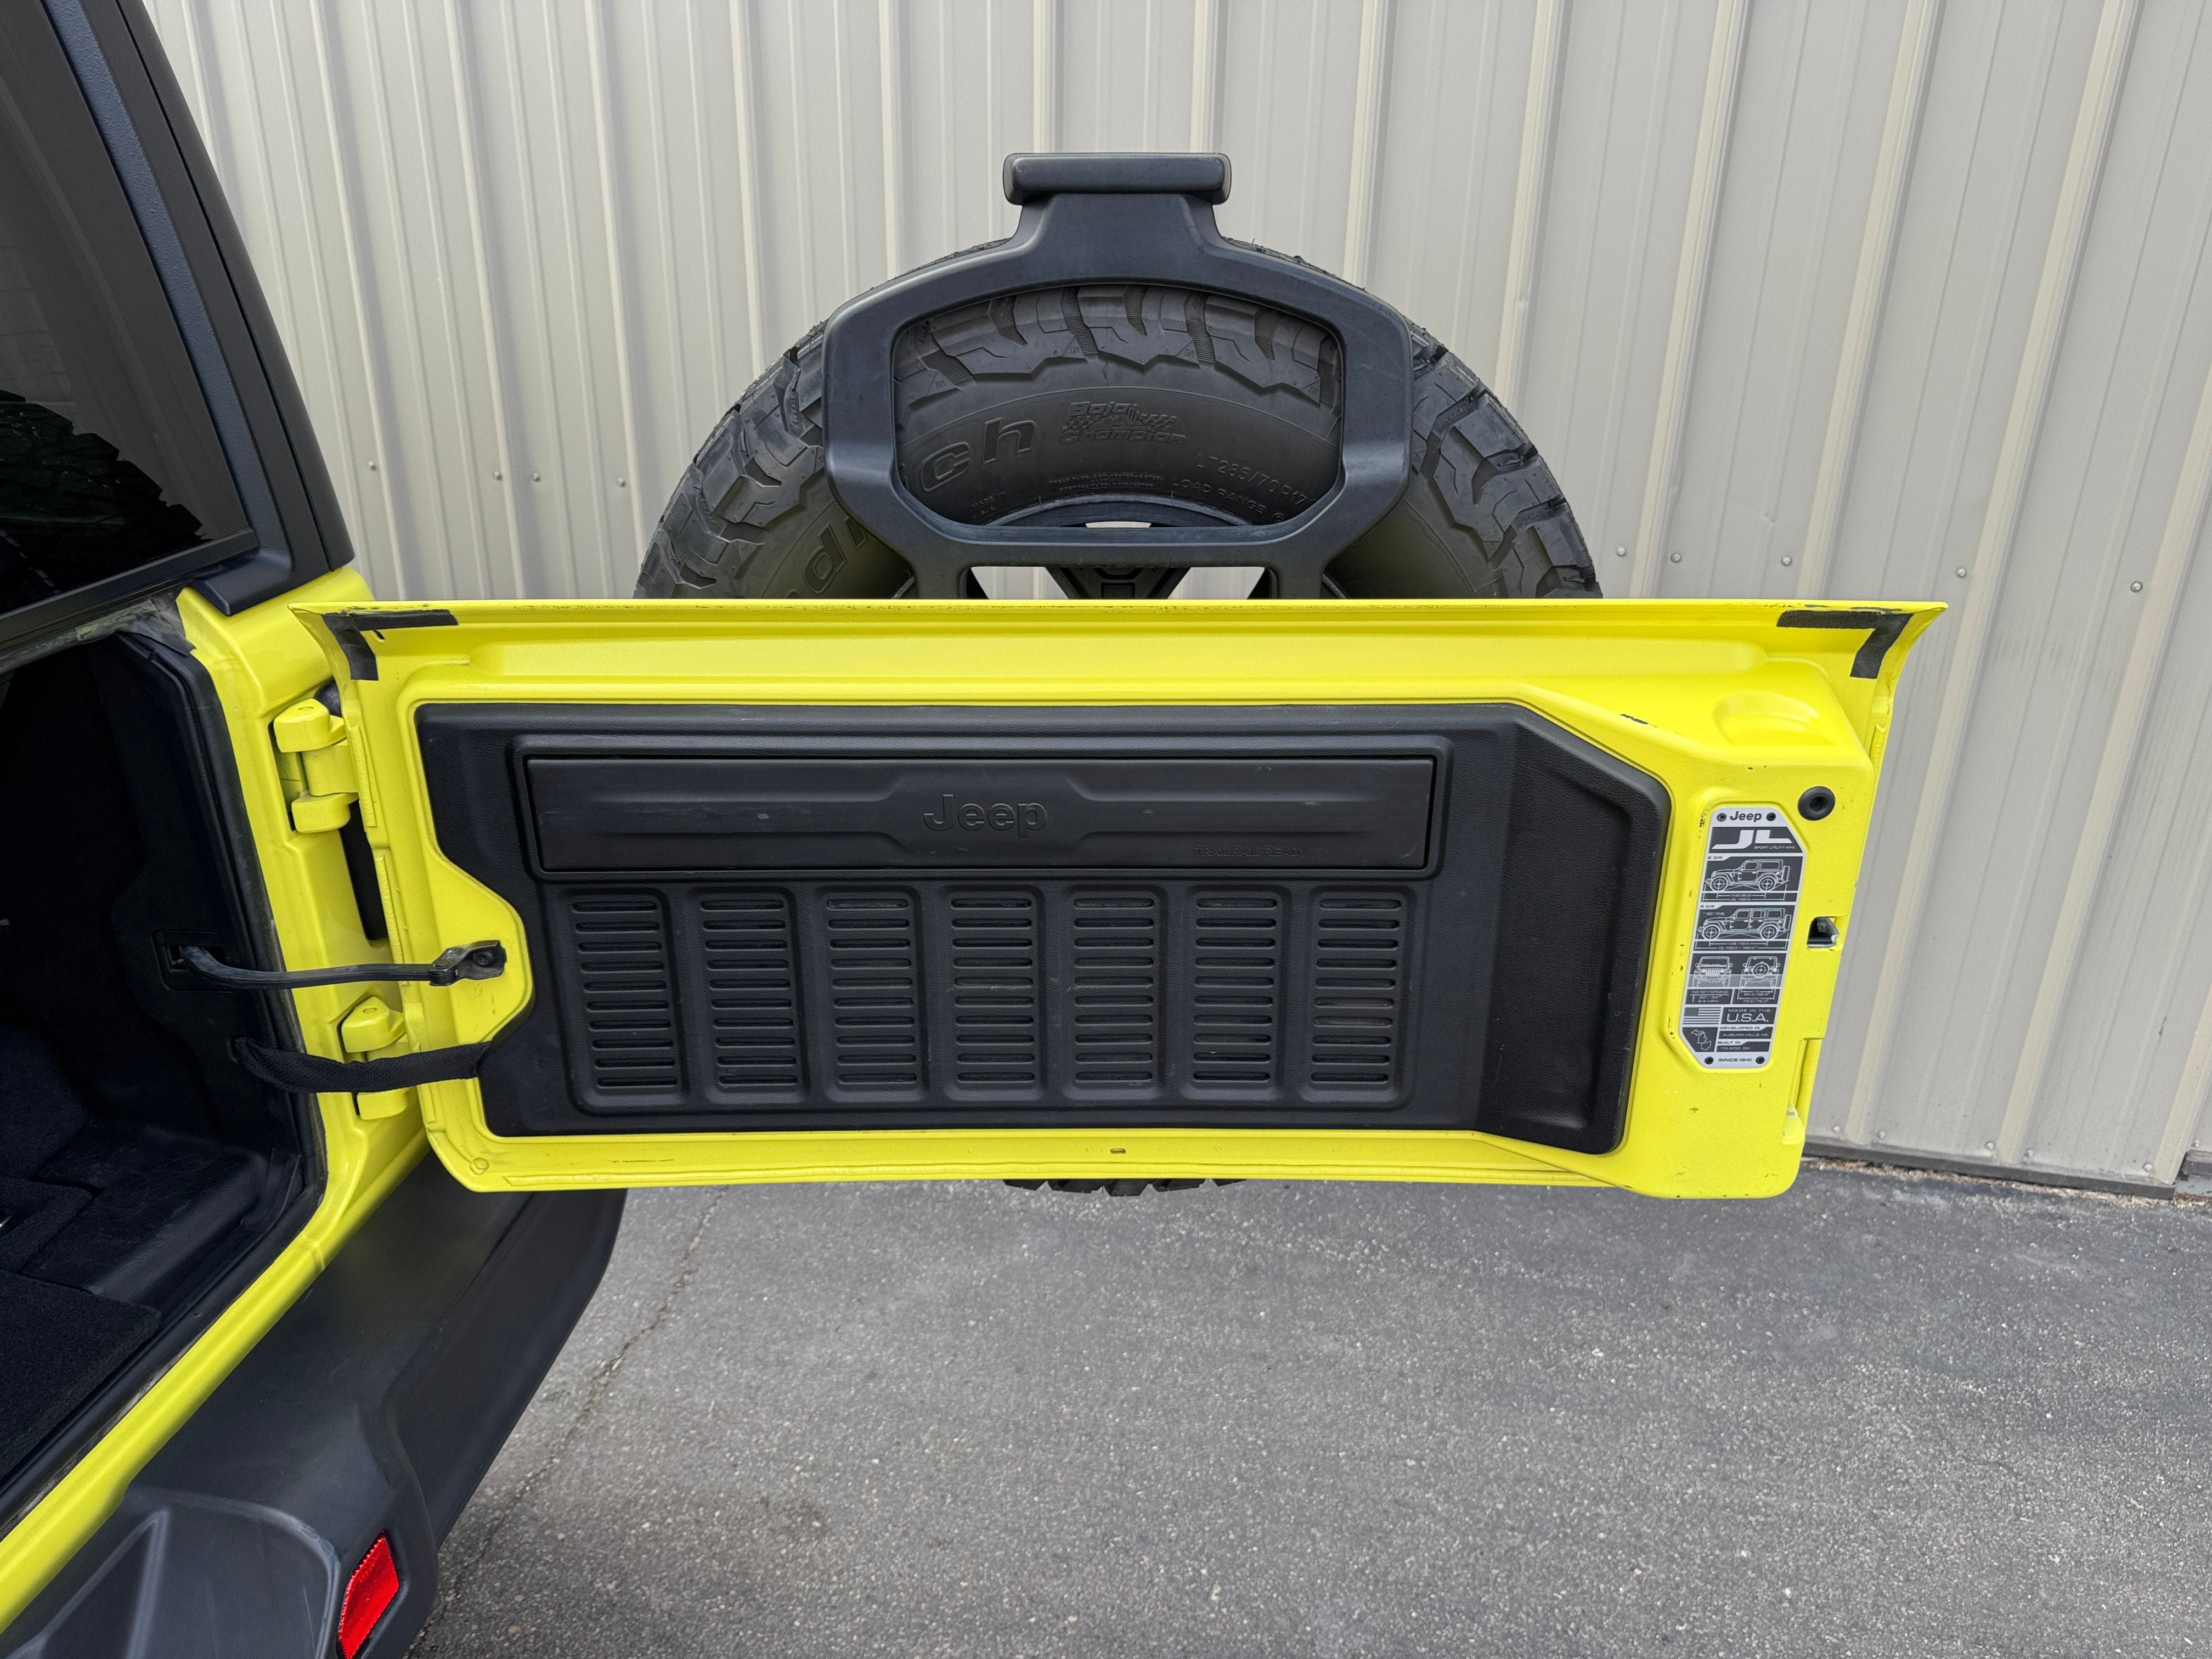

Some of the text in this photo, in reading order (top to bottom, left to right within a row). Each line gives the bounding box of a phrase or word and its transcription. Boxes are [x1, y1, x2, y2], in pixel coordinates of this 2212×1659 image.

[1066, 401, 1131, 417] Baja
[1059, 430, 1186, 444] Champion
[971, 496, 995, 508] MADE
[1172, 477, 1211, 493] LOAD
[1217, 488, 1267, 514] RANGE
[923, 794, 1047, 838] Jeep
[1730, 811, 1762, 822] Jeep
[1712, 830, 1792, 849] JL
[1194, 847, 1308, 857] TRAILRAIL READY
[1726, 1013, 1769, 1022] U.S.A.
